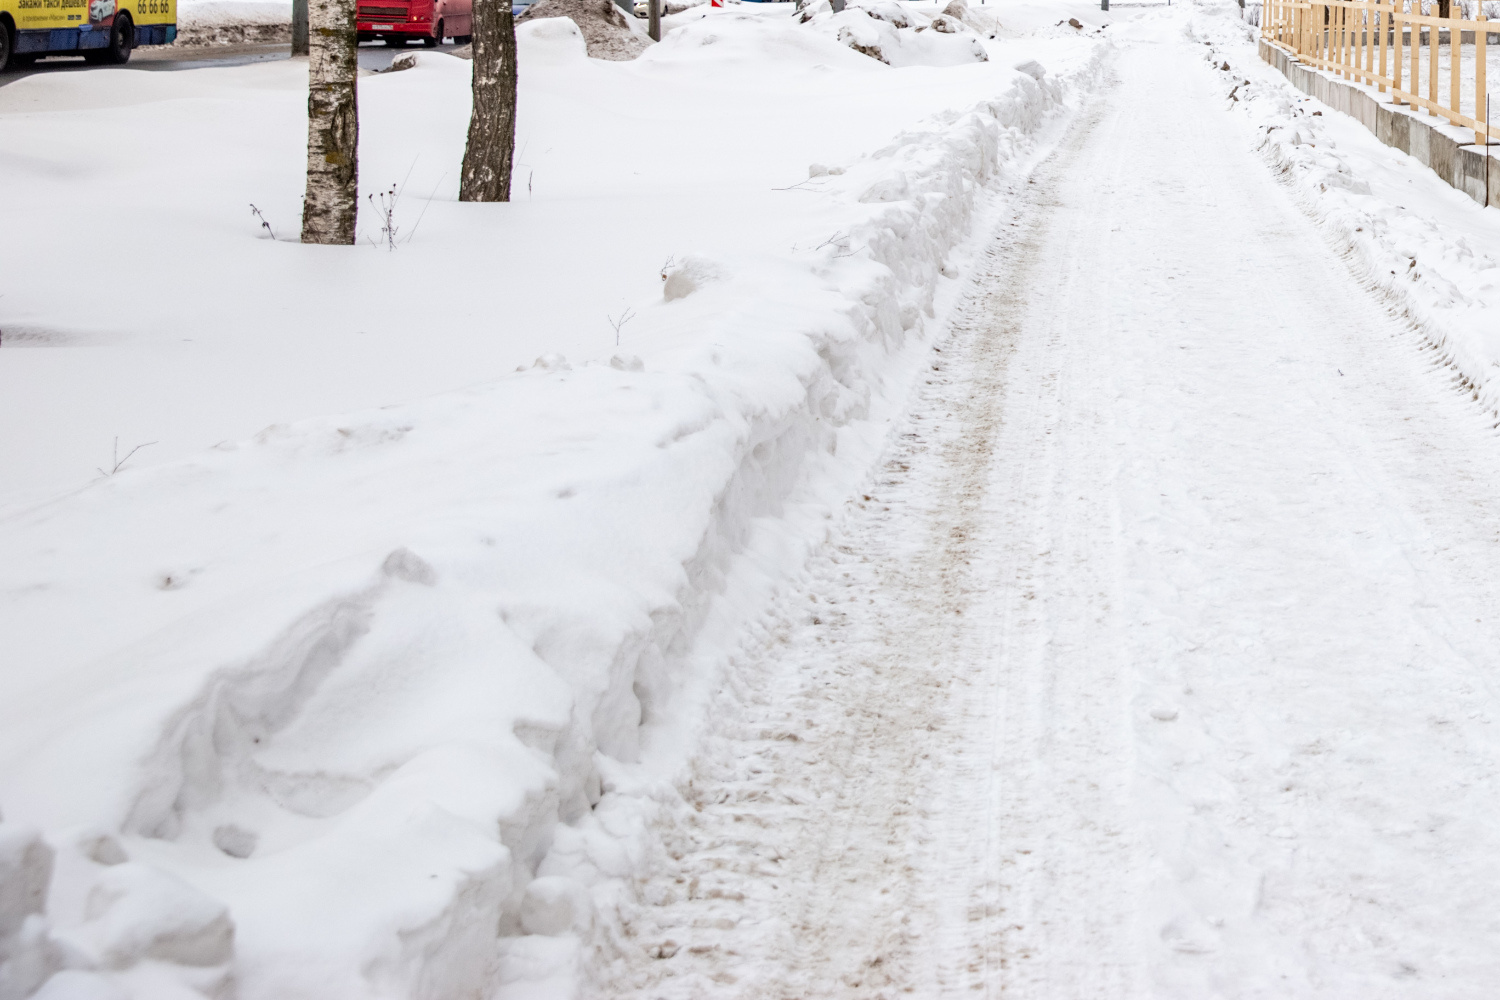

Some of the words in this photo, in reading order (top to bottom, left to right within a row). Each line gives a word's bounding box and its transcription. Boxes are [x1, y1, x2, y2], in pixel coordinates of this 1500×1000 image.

[43, 0, 60, 9] такси
[137, 0, 147, 15] 66
[149, 0, 158, 15] 66
